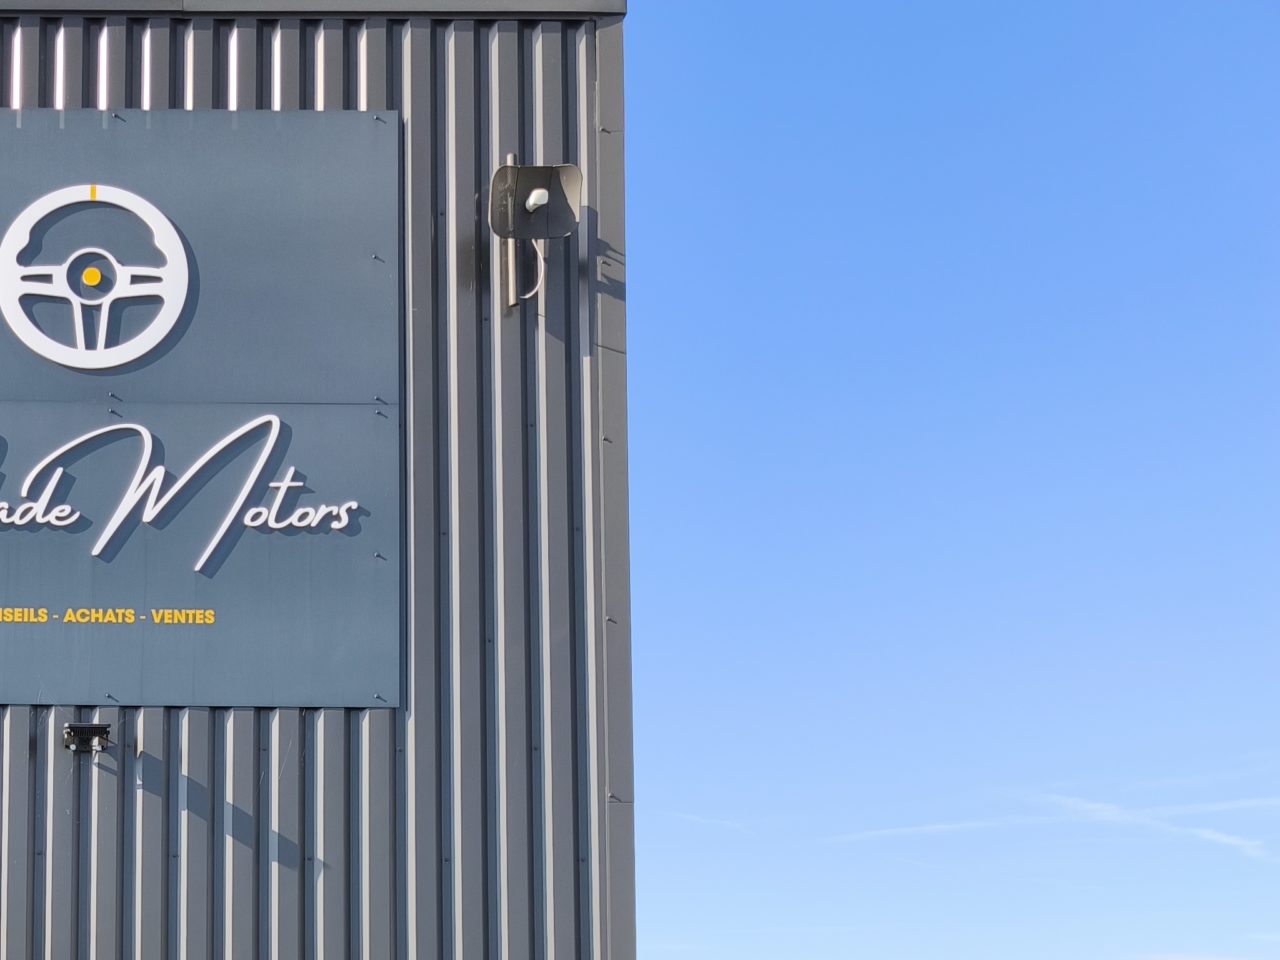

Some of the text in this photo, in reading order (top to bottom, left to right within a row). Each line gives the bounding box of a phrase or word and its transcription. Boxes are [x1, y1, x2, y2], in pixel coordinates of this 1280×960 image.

[21, 413, 360, 573] Motors
[63, 608, 136, 624] ACHATS
[150, 608, 216, 625] VENTES
